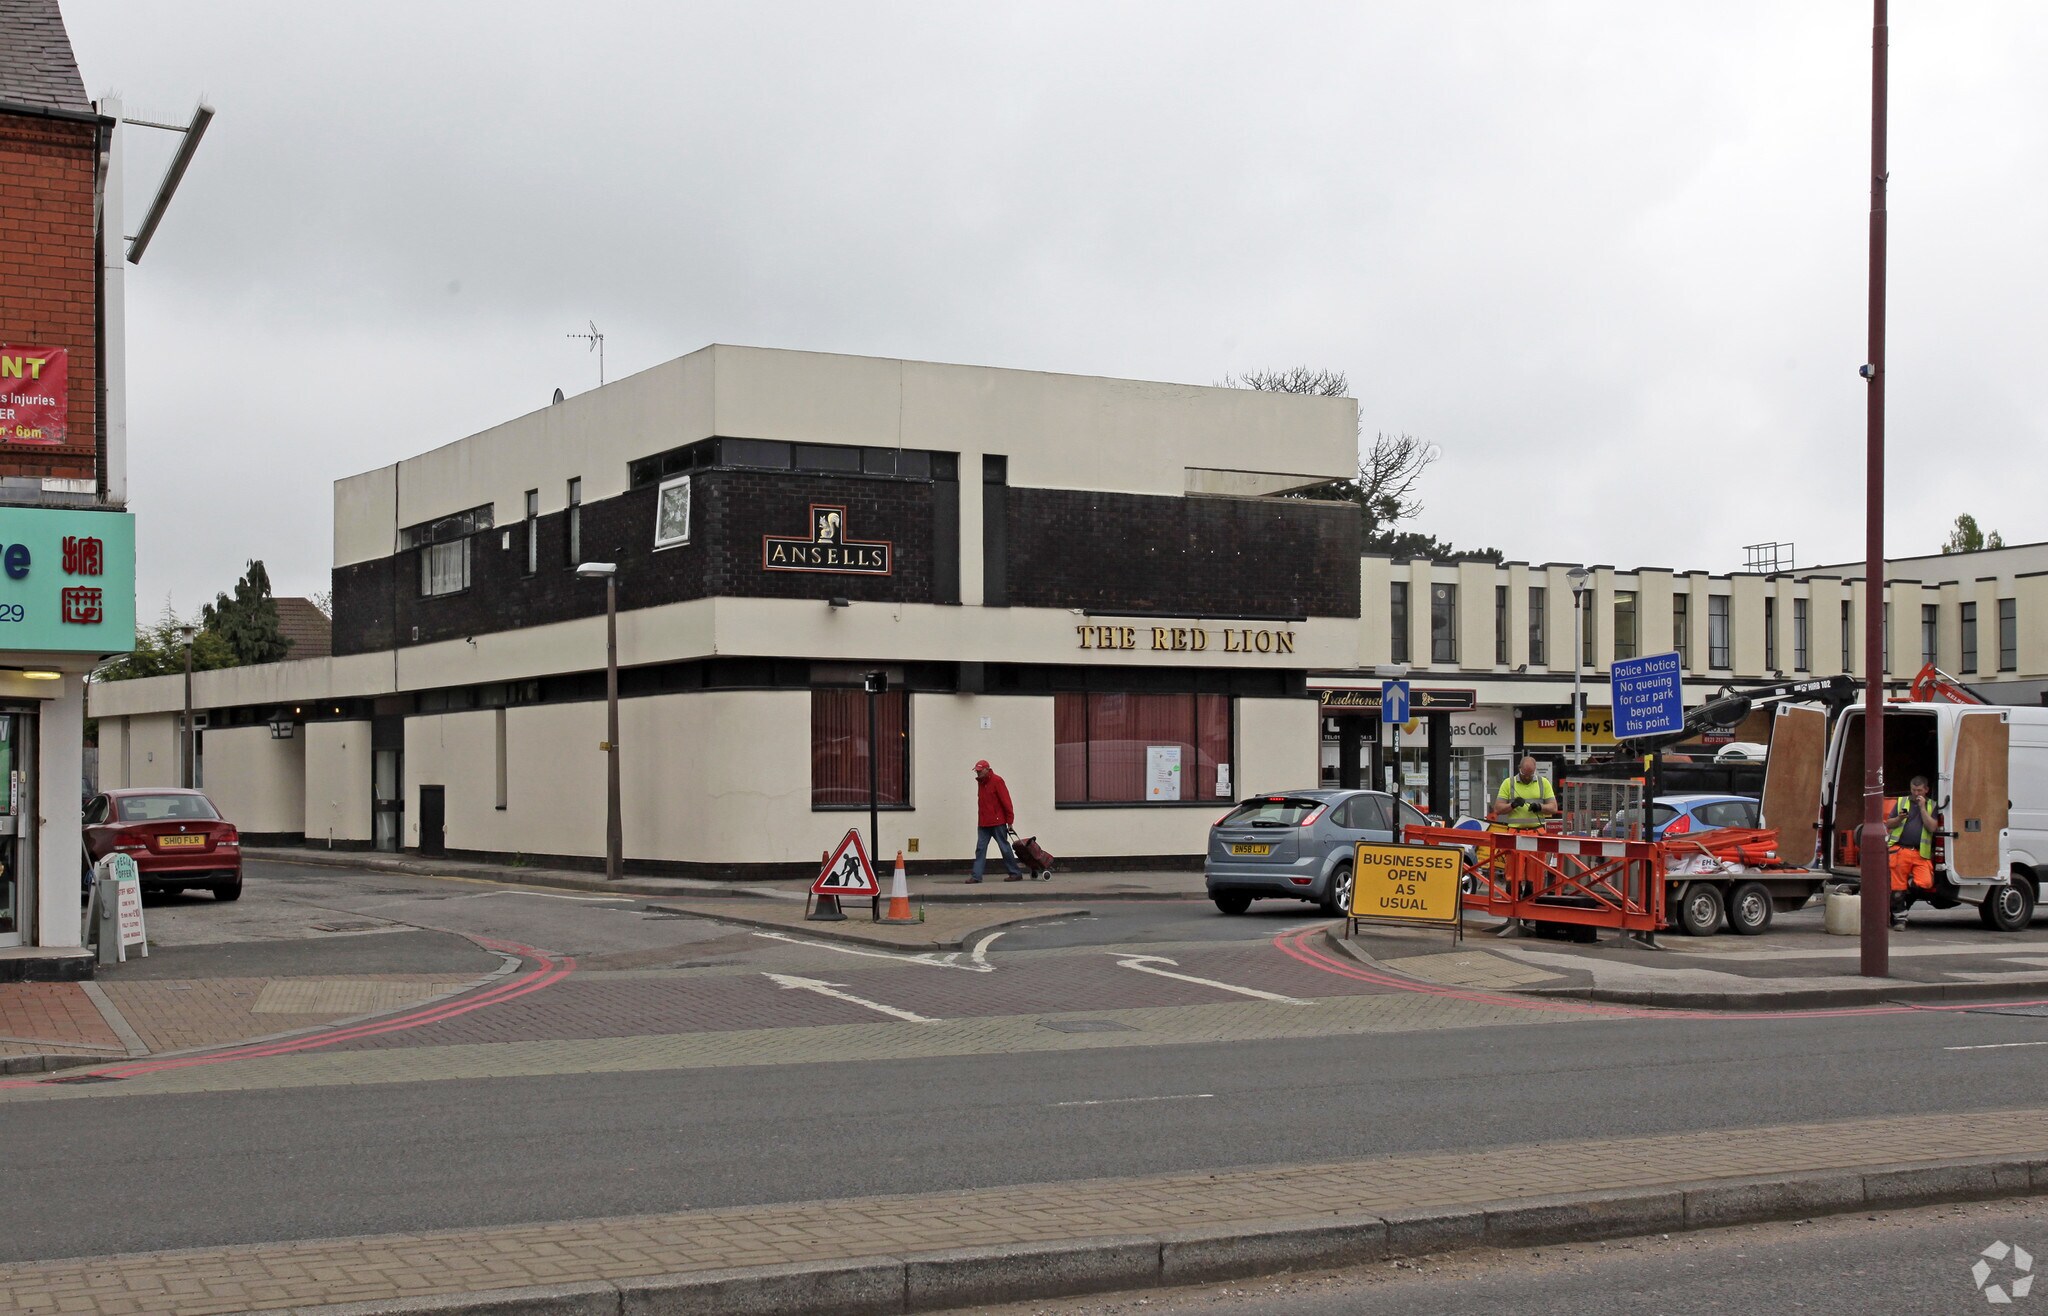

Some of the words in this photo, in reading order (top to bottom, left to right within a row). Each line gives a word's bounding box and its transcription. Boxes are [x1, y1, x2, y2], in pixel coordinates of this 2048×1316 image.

[2, 356, 45, 379] NT
[11, 393, 56, 407] Injuries
[16, 425, 42, 438] 6pm
[0, 544, 31, 579] e
[771, 544, 882, 567] ANSELLS
[0, 604, 25, 622] 29
[1077, 626, 1136, 650] THE
[1151, 627, 1210, 651] RED
[1224, 628, 1296, 654] LION
[1615, 665, 1642, 678] Police
[1645, 660, 1676, 673] Notice
[1620, 681, 1633, 692] No
[1636, 676, 1672, 691] queuing
[1322, 690, 1382, 706] Traditiona
[1620, 695, 1633, 706] for
[1635, 693, 1650, 703] car
[1653, 689, 1674, 702] park
[1630, 703, 1663, 717] beyond
[1468, 722, 1498, 736] Cook
[1540, 719, 1555, 727] The
[1557, 720, 1600, 736] Moey
[1626, 719, 1643, 731] this
[1646, 716, 1670, 730] point
[1234, 845, 1252, 853] BN58
[1253, 845, 1267, 853] LJV
[115, 856, 135, 874] SPECIAL
[1363, 853, 1453, 869] BUSINESSES
[118, 869, 133, 879] OFFER
[1387, 869, 1427, 882] OPEN
[1395, 884, 1416, 895] AS
[1380, 897, 1428, 910] USUAL
